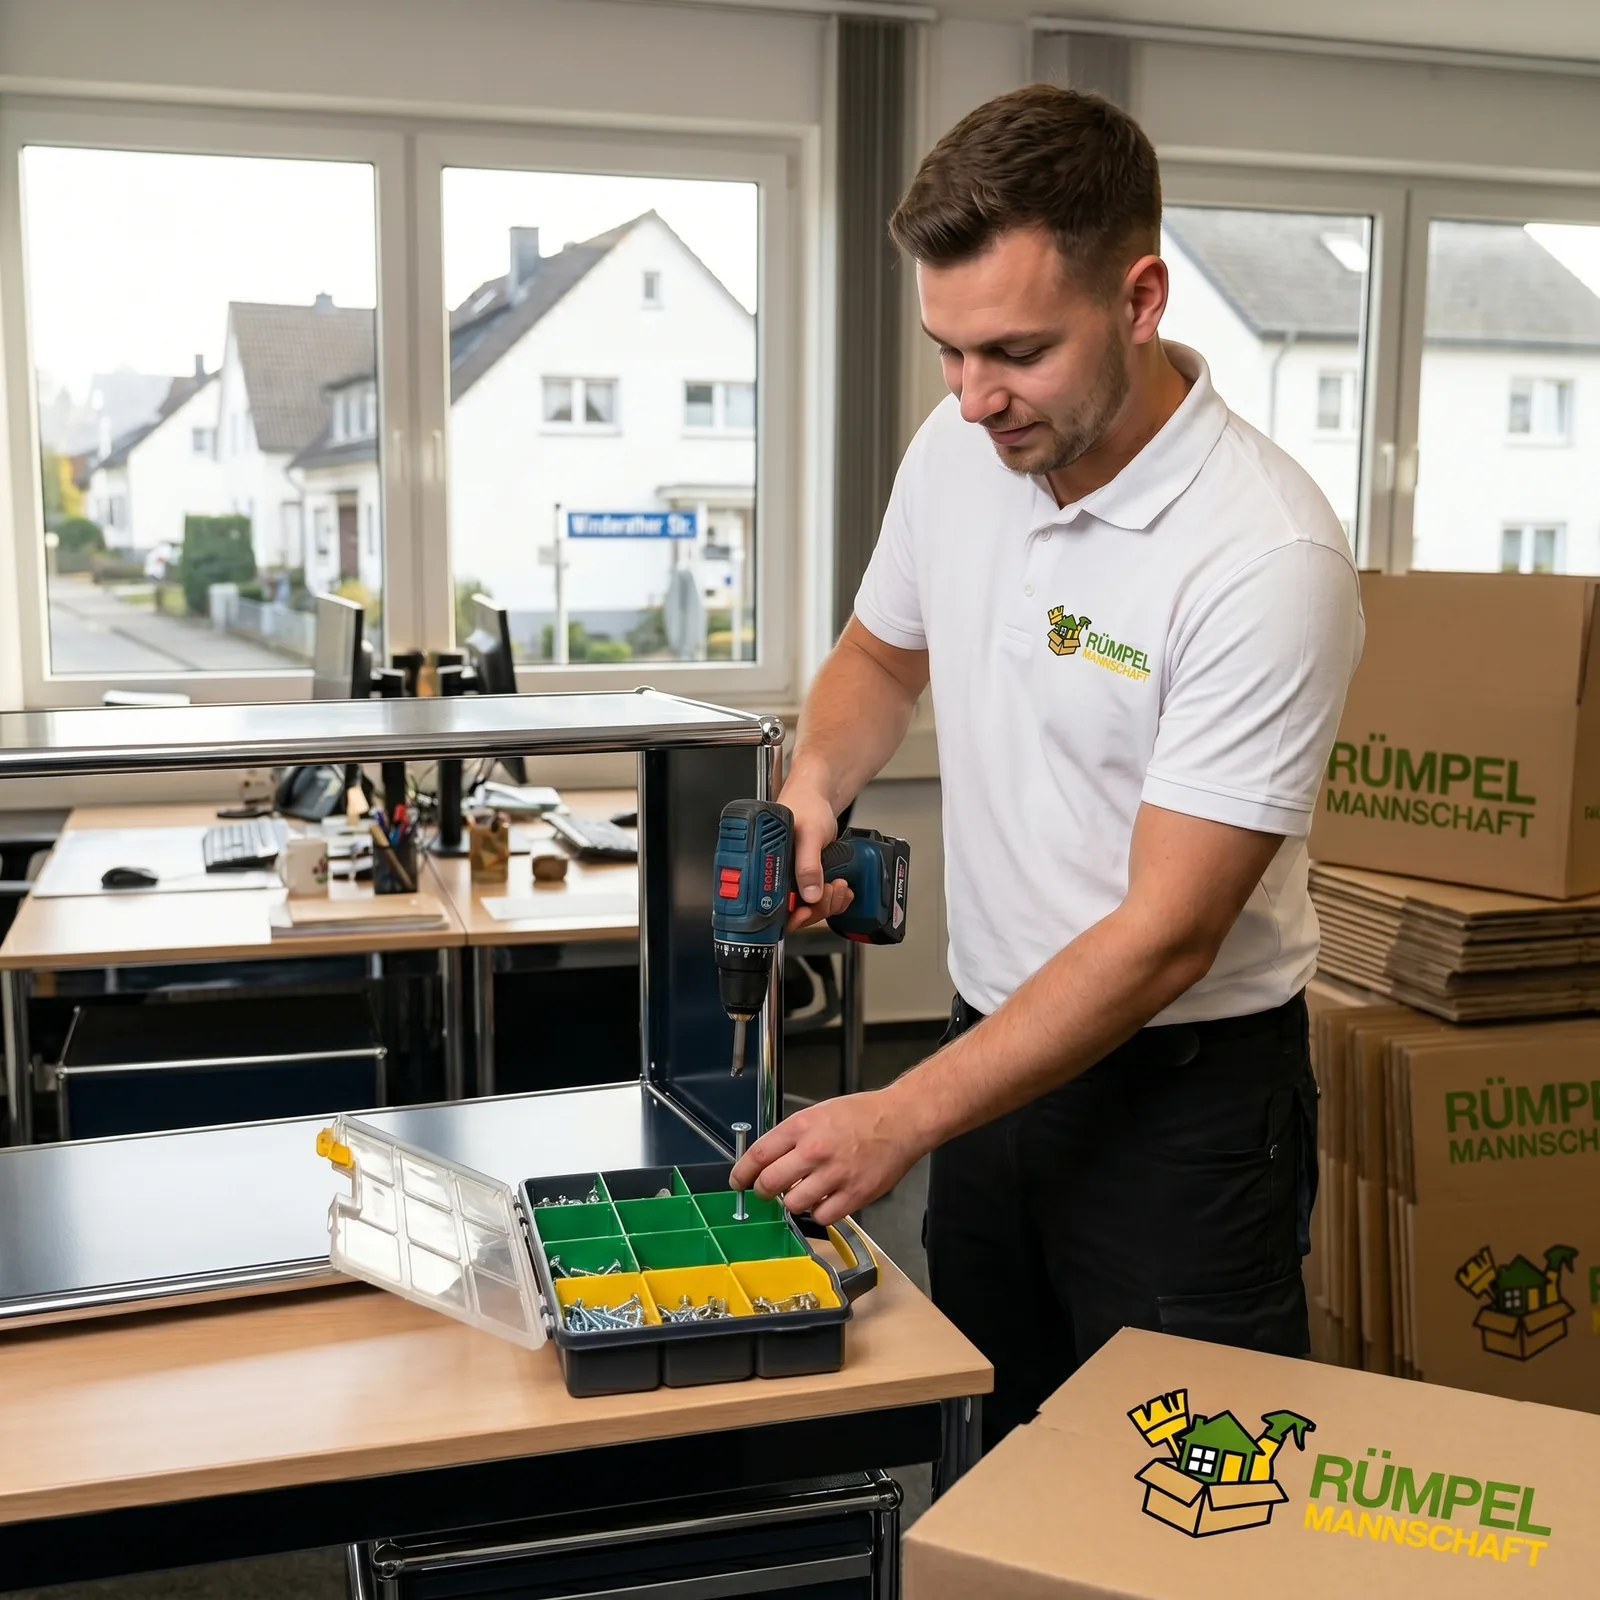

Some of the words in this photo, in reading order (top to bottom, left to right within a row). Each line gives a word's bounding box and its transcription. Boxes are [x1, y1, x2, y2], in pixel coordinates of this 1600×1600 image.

[1082, 649, 1150, 684] MANNSCHAFT
[1086, 632, 1151, 673] RÜMPEL
[1327, 733, 1536, 805] RÜMPEL
[1326, 789, 1535, 838] MANNSCHAFT
[1309, 1447, 1552, 1536] RÜMPEL
[1303, 1503, 1547, 1566] MANNSCHAFT
